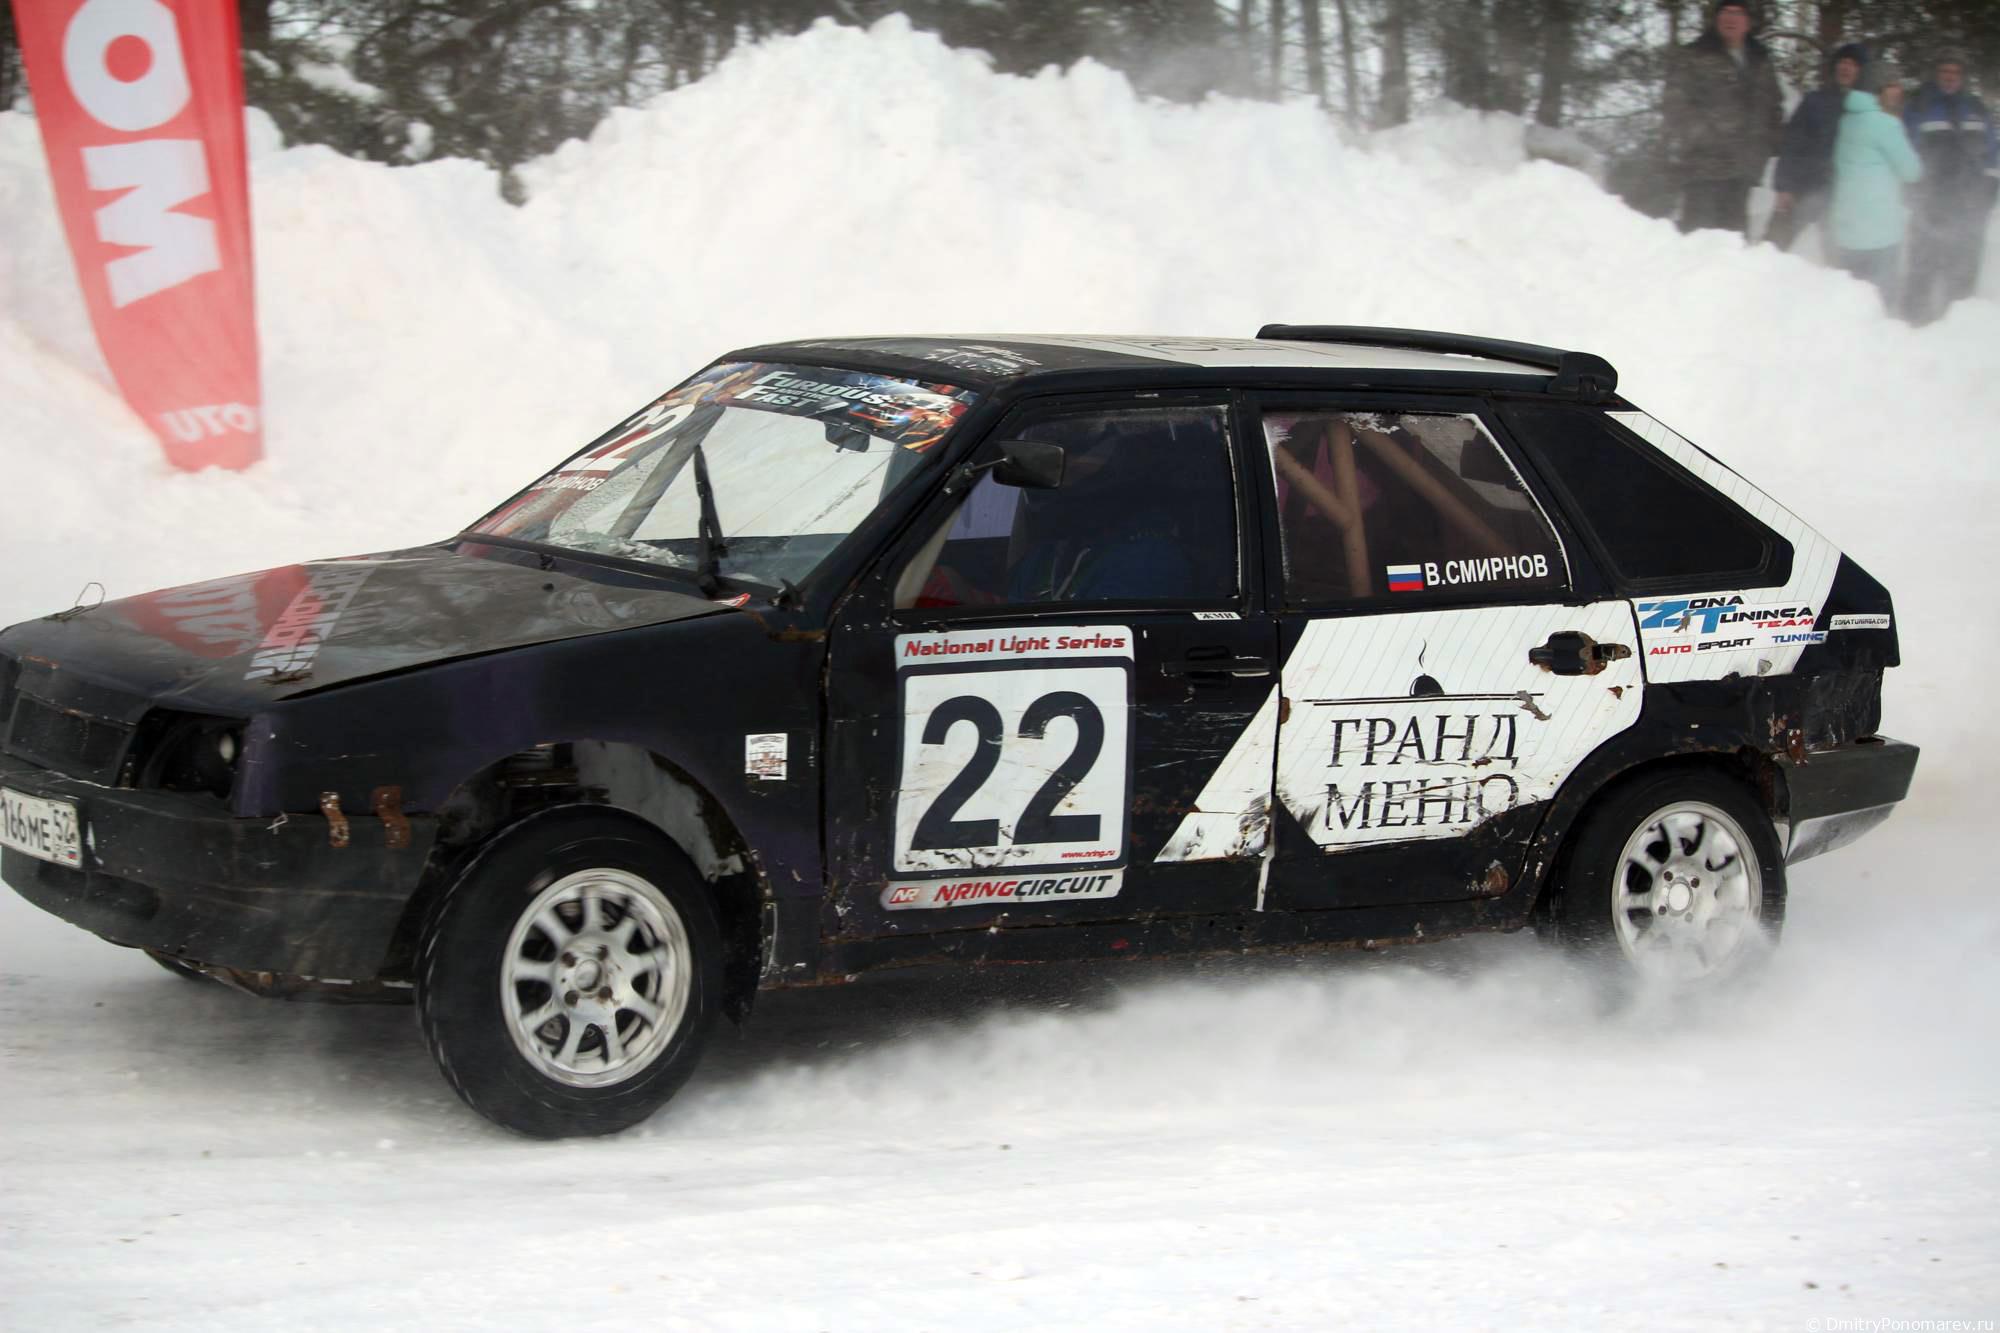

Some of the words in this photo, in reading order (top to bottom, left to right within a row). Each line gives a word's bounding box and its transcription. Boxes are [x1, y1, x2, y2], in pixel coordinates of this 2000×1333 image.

[1424, 554, 1548, 586] В.СМИРНОВ
[1752, 618, 1814, 629] TEAM
[904, 639, 994, 657] National
[1000, 636, 1050, 653] Light
[1056, 633, 1126, 649] Series
[1650, 645, 1692, 656] AUTO
[1697, 637, 1755, 651] SPORT
[1326, 714, 1519, 769] ГРАНД
[910, 691, 1105, 850] 22
